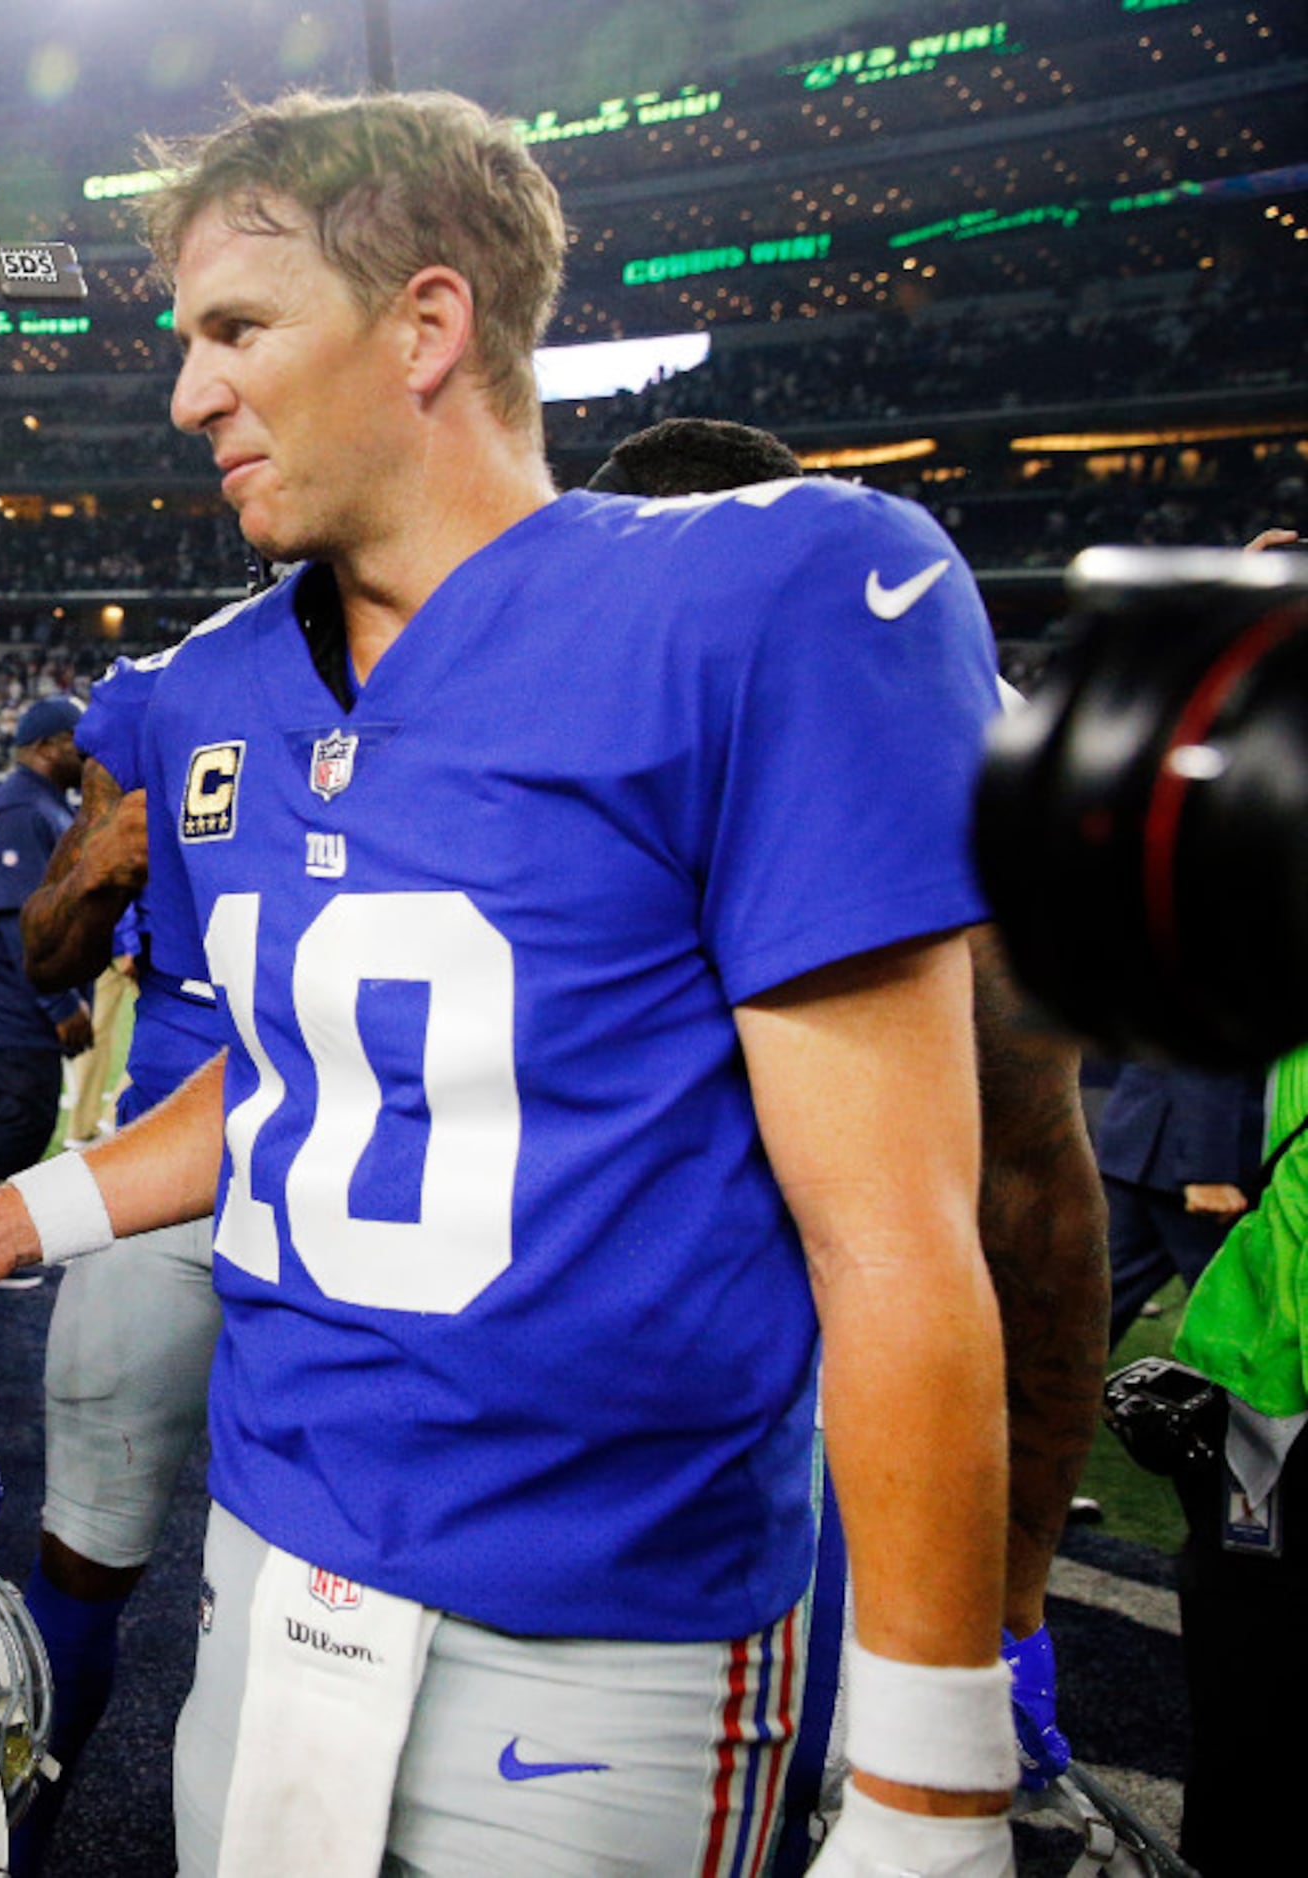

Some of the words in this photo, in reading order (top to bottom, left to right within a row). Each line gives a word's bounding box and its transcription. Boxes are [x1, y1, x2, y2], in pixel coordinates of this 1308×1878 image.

[4, 255, 52, 274] SDS
[187, 746, 238, 817] C
[202, 890, 522, 1315] 10
[312, 1566, 359, 1604] NFL
[285, 1616, 374, 1663] Wilson
